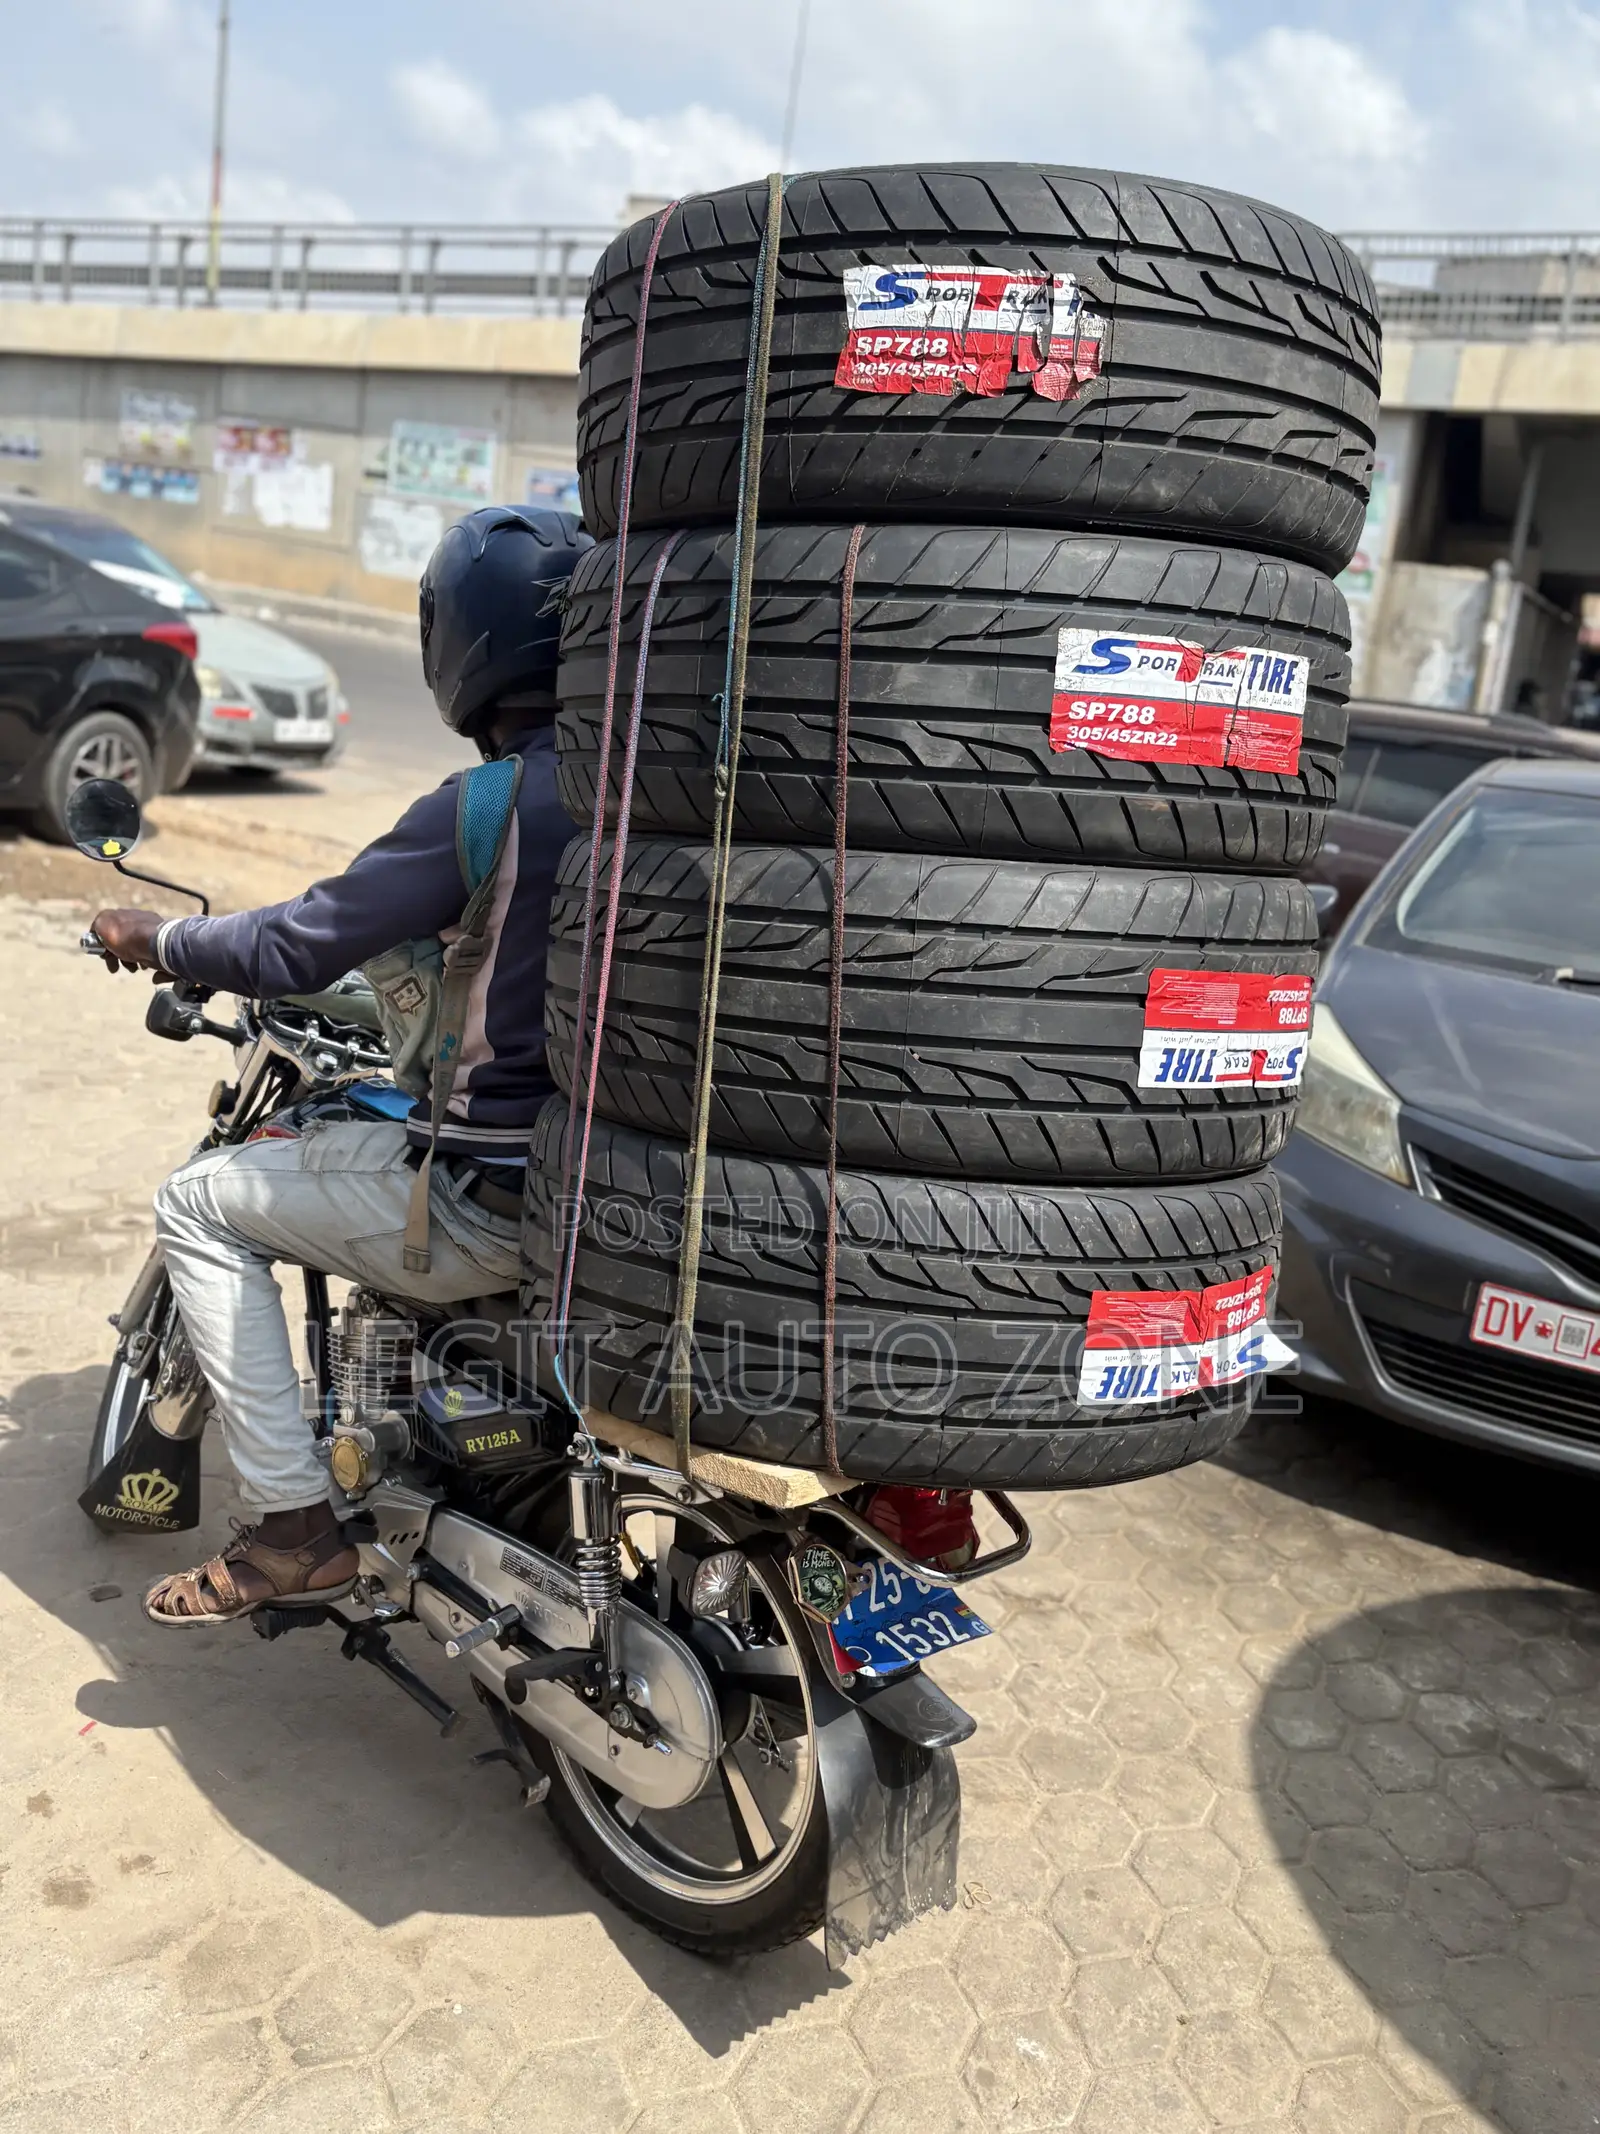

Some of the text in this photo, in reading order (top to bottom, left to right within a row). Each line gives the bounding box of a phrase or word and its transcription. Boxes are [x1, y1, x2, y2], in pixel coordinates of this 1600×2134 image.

[856, 337, 949, 358] SP788
[1247, 654, 1299, 695] TIRE
[1068, 701, 1156, 725] SP788
[1067, 727, 1178, 747] 305/45ZR22
[1278, 1007, 1307, 1024] SP788
[1154, 1048, 1217, 1082] TIRE
[1482, 1295, 1535, 1342] DV
[1095, 1364, 1161, 1399] TIRE
[465, 1429, 521, 1454] RY125A
[94, 1503, 180, 1529] MOTORCYCLE
[806, 1547, 830, 1560] TIME
[810, 1560, 836, 1569] MONEY
[875, 1611, 971, 1661] 1532
